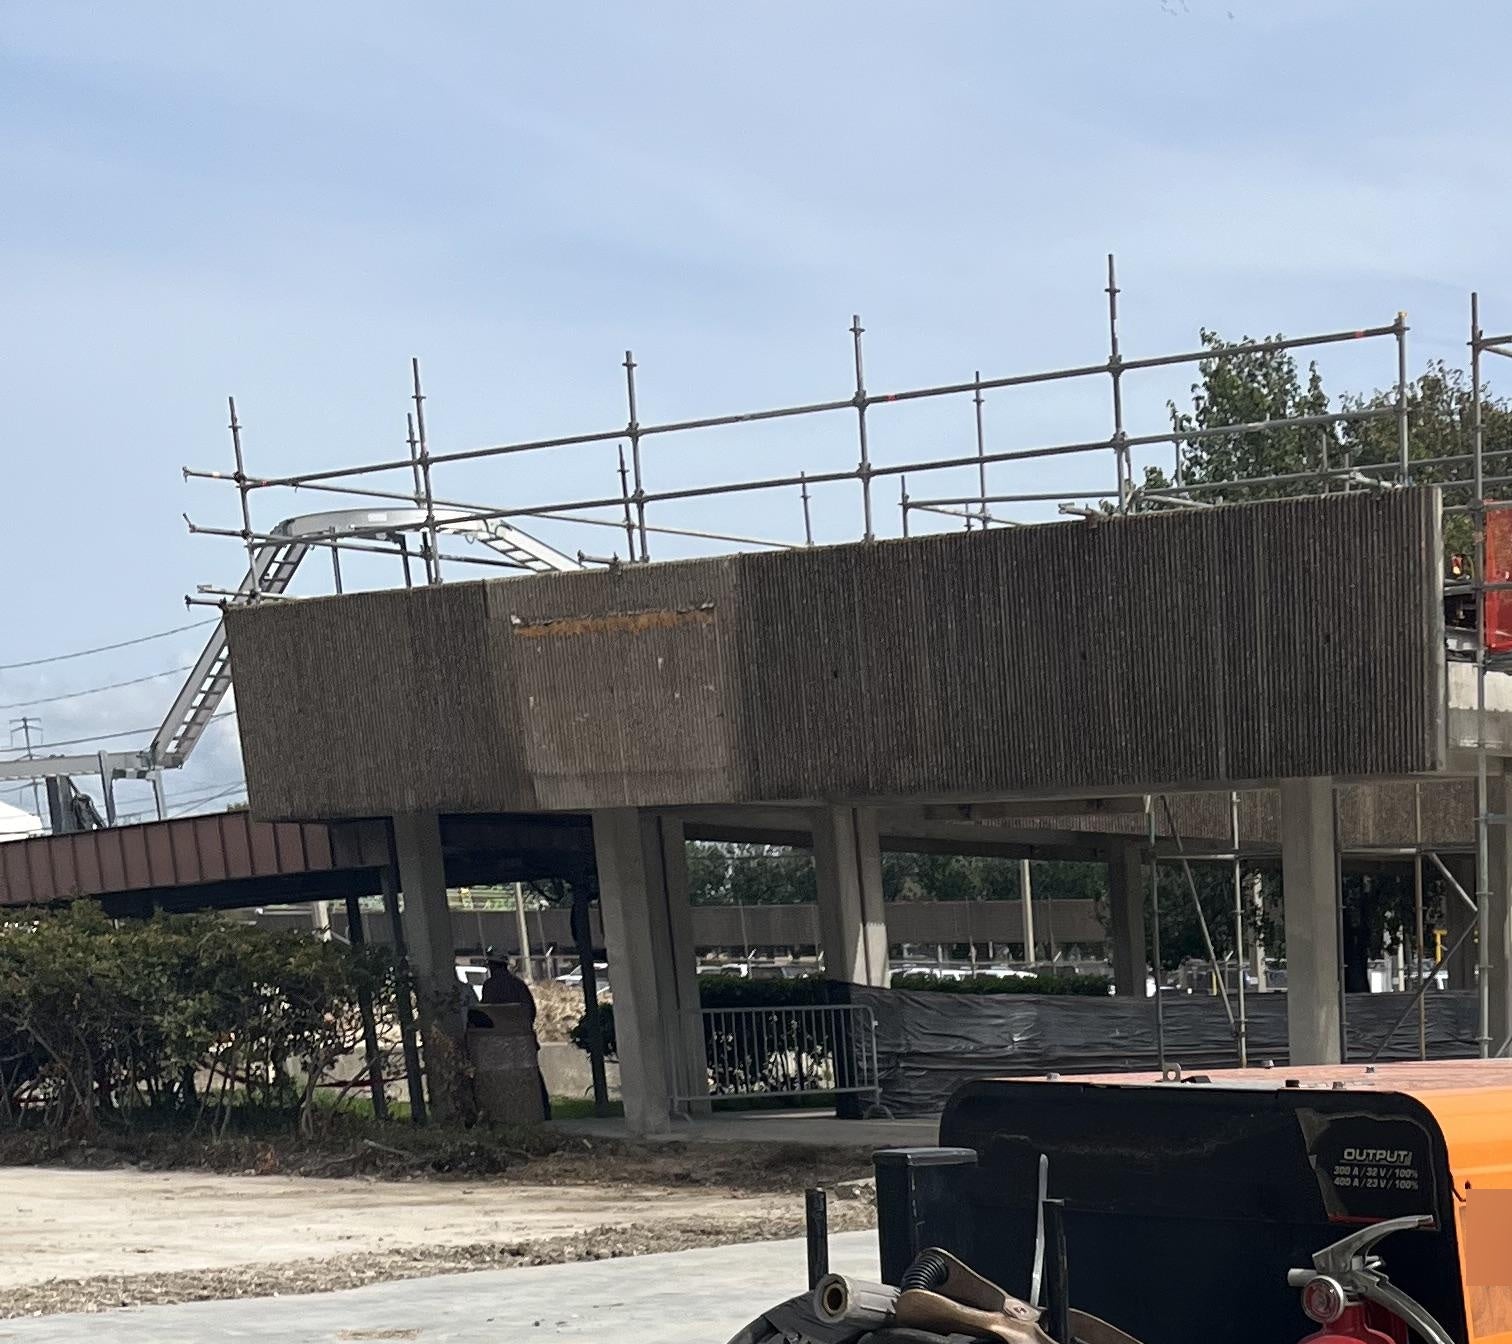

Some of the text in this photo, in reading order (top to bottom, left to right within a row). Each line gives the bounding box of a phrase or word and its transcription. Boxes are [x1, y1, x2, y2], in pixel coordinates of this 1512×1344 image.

[1343, 1148, 1408, 1162] OUTPUT
[1333, 1166, 1350, 1175] 300
[1352, 1166, 1359, 1176] A
[1380, 1168, 1387, 1177] V
[1333, 1177, 1351, 1186] 400
[1352, 1178, 1359, 1187] A
[1380, 1179, 1387, 1188] V
